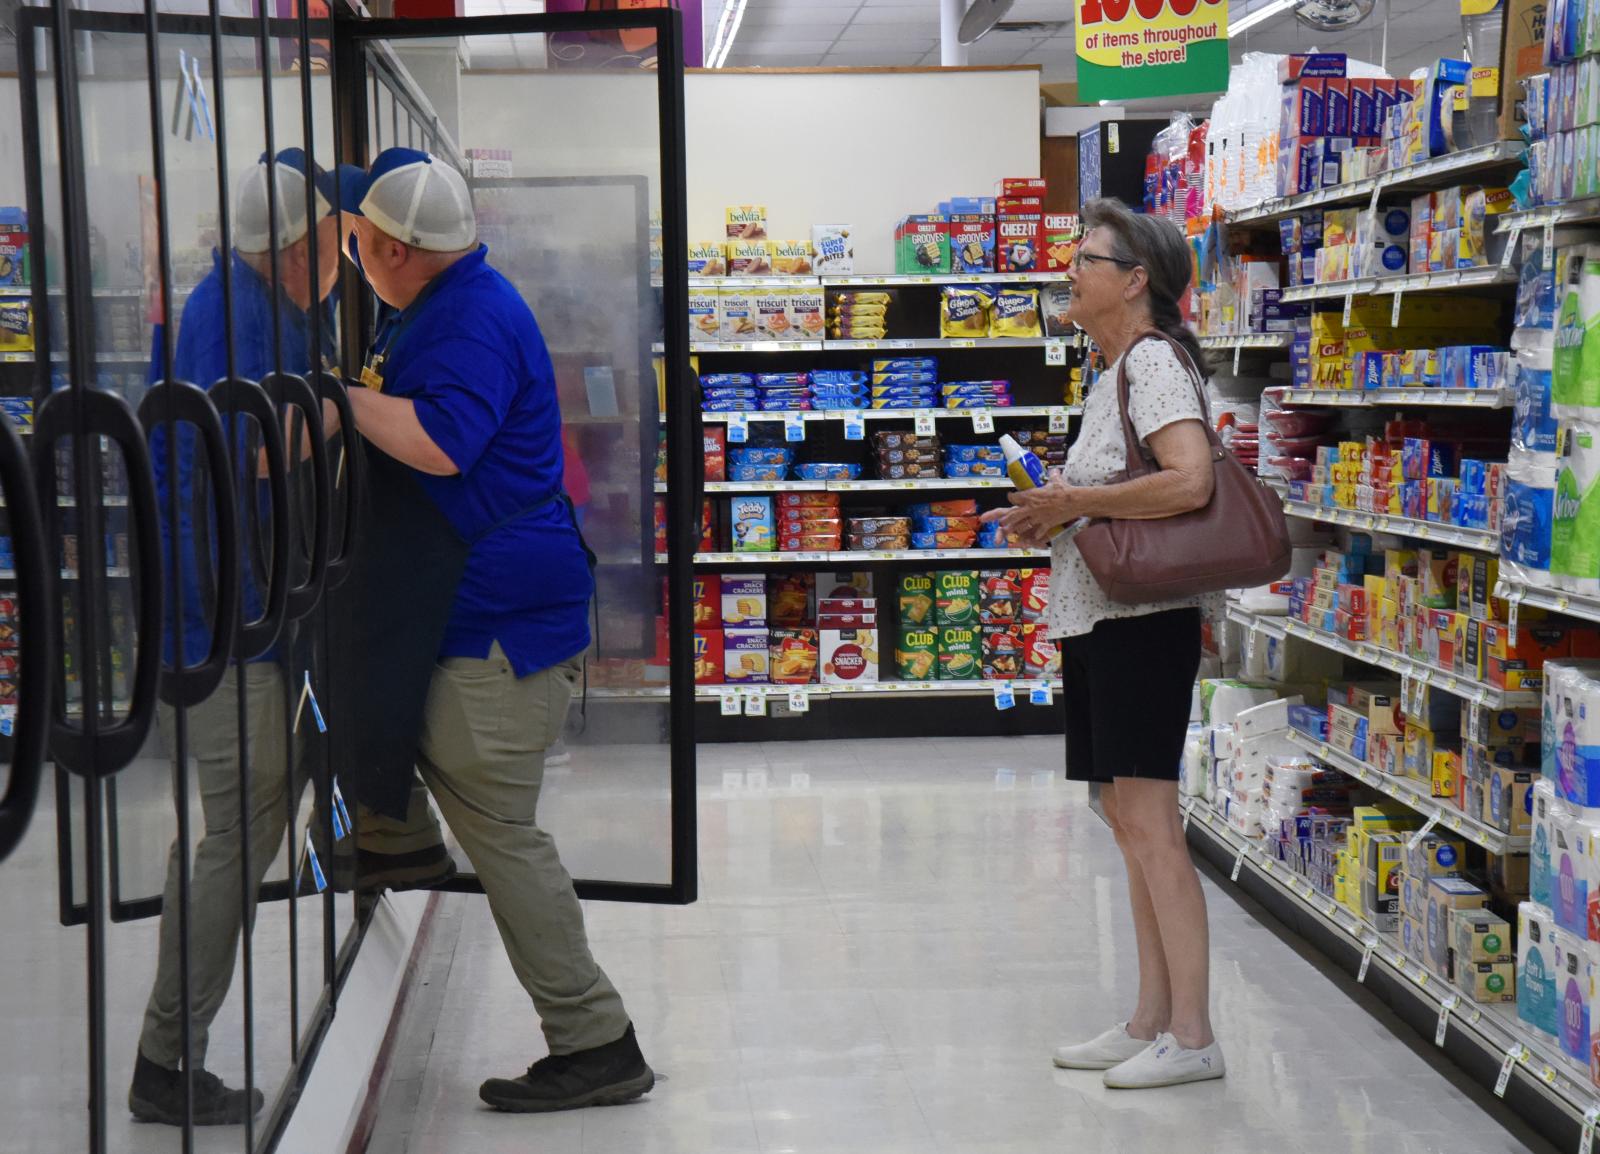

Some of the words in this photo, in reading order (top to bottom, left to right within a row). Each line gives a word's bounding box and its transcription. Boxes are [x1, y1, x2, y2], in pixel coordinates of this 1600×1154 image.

[1085, 34, 1099, 49] of
[1103, 32, 1139, 48] items
[1143, 22, 1217, 44] throughout
[1121, 51, 1143, 66] the
[1147, 46, 1186, 64] store!
[821, 237, 844, 249] SUPER
[912, 232, 945, 244] GROOVES
[957, 231, 990, 244] GROOVES
[823, 244, 846, 255] FOOD
[824, 252, 845, 262] BITES
[724, 299, 749, 307] triscuit
[757, 299, 787, 308] triscuit
[791, 298, 821, 307] triscuit
[1368, 359, 1378, 384] Ziploc
[1432, 448, 1442, 475] Ziploc
[739, 502, 764, 515] Teddy
[903, 577, 931, 591] CLUB
[942, 575, 970, 589] CLUB
[946, 588, 968, 597] minis
[906, 633, 934, 647] CLUB
[945, 630, 973, 644] CLUB
[948, 643, 971, 652] minis
[834, 657, 863, 666] SNACKER
